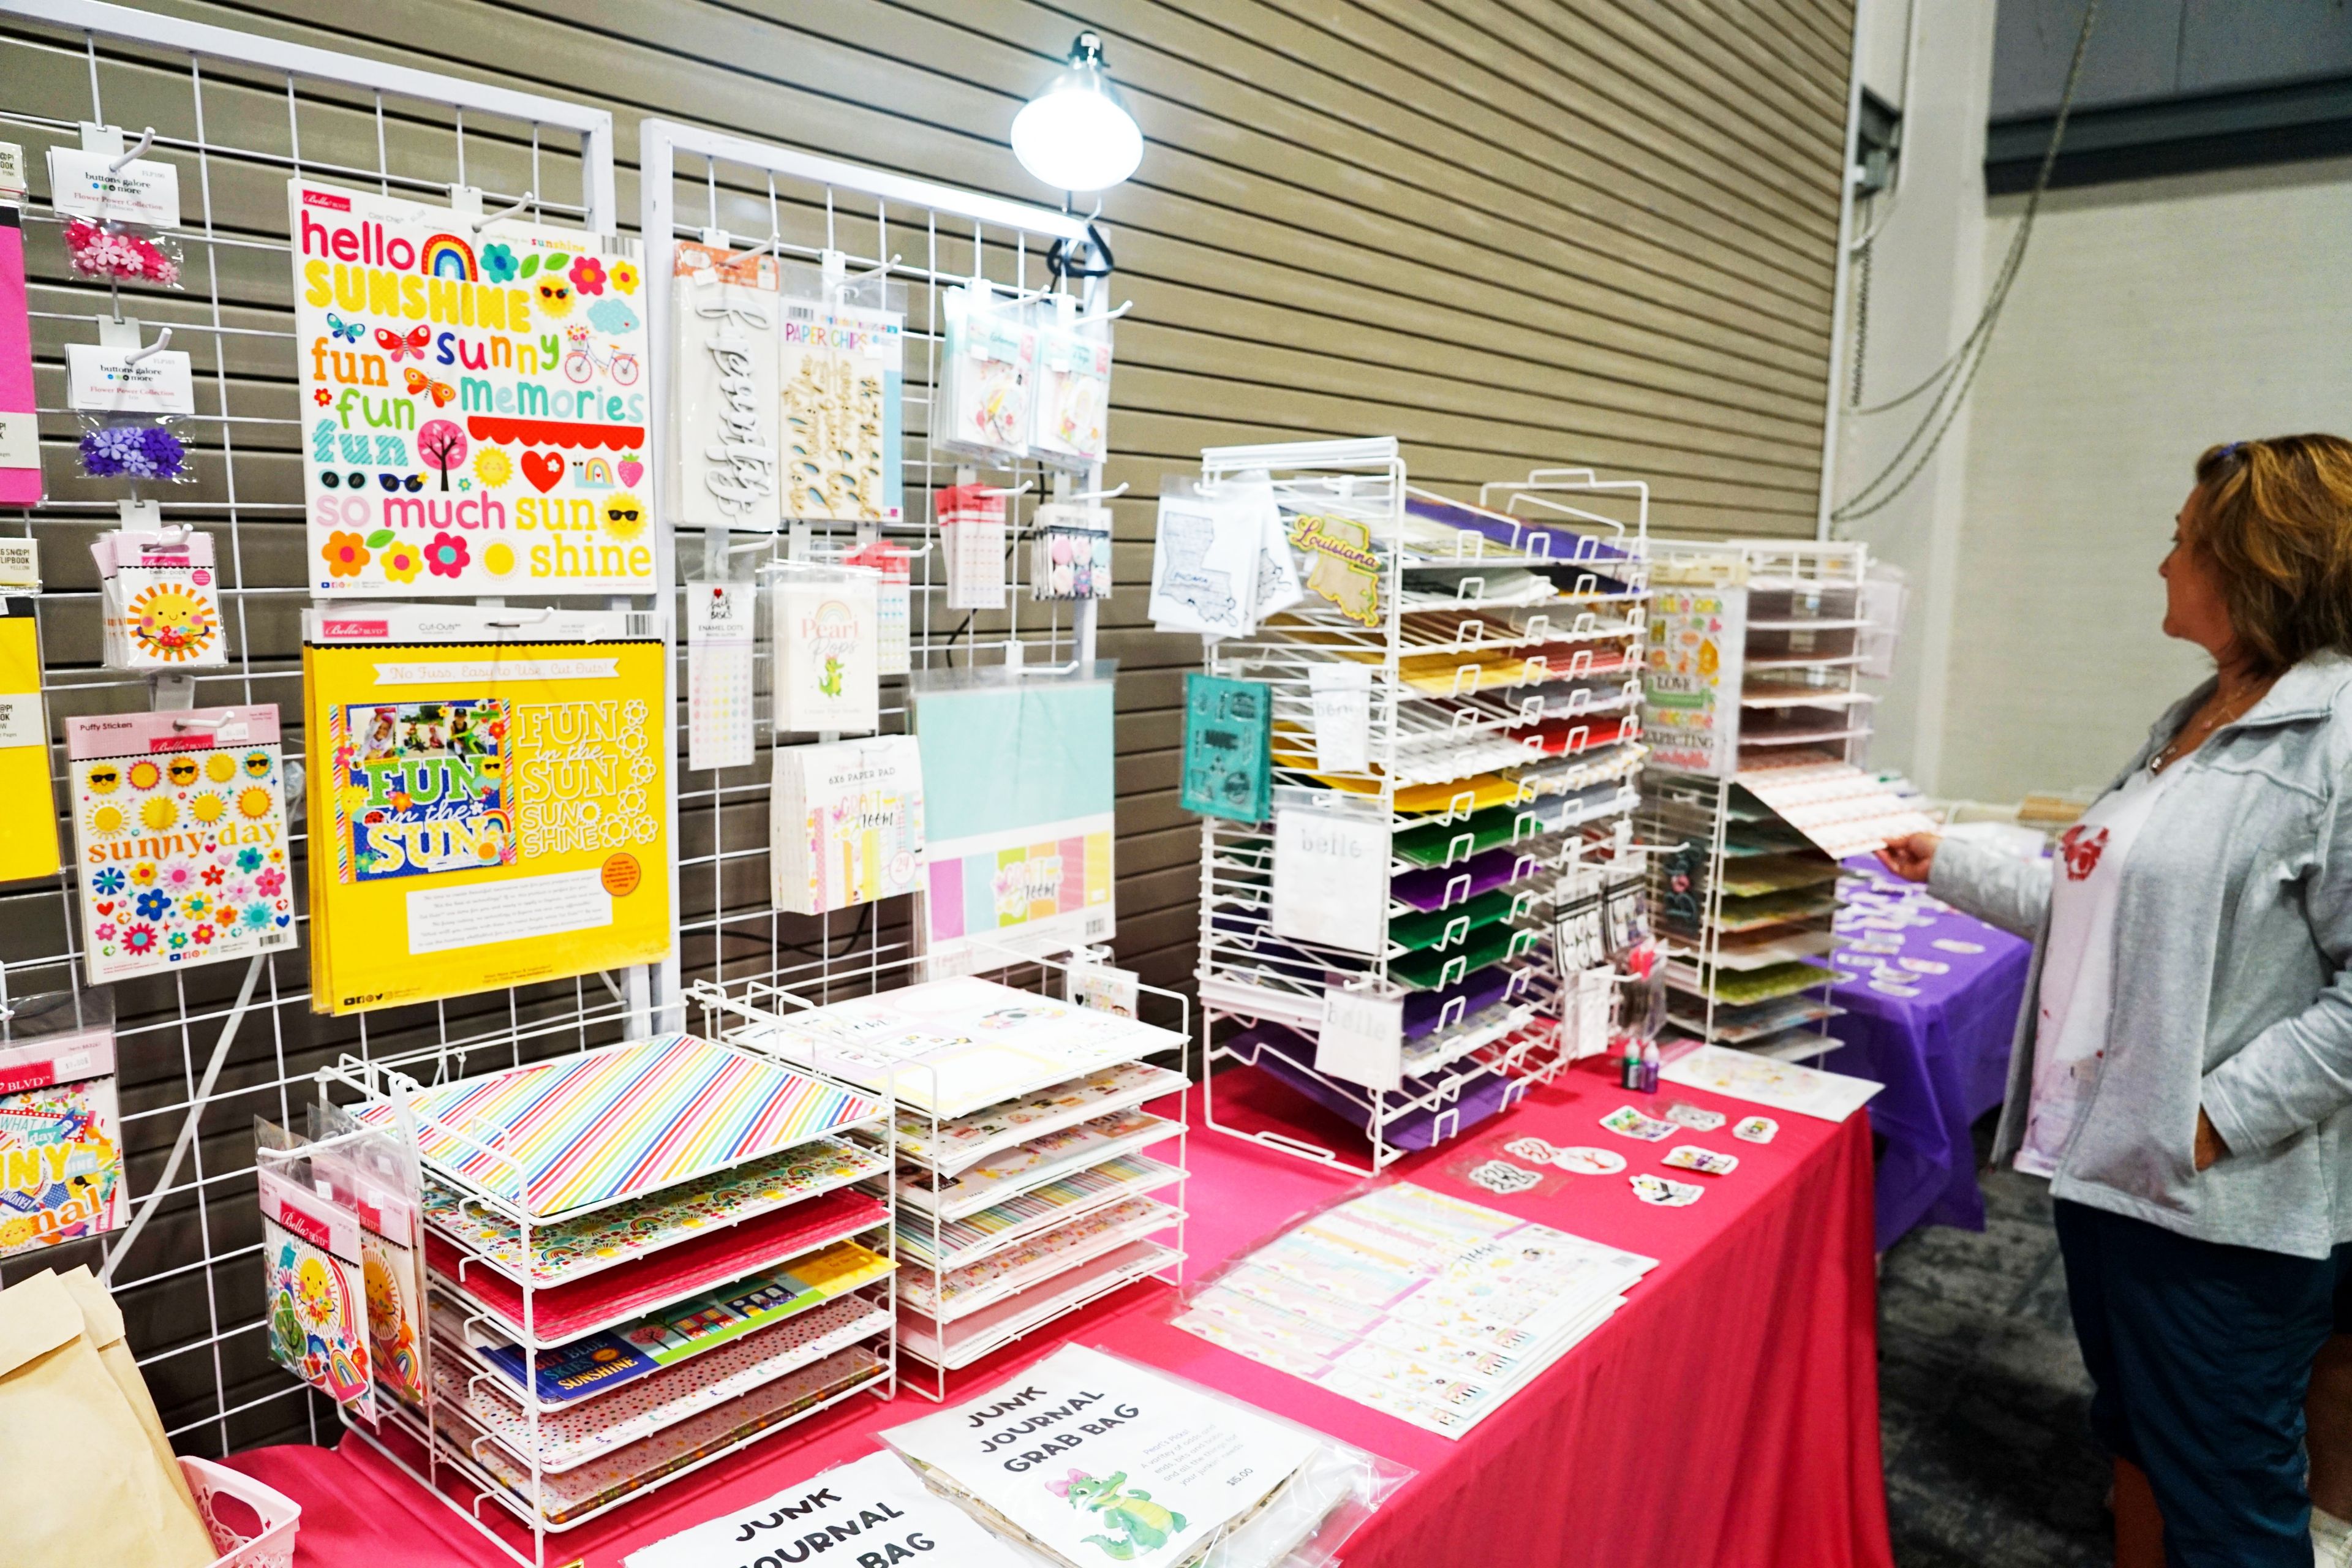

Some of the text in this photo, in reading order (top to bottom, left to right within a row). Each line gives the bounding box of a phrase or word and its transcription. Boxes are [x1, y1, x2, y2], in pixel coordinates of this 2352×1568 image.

[85, 172, 151, 189] buttons galore
[74, 192, 163, 210] Flower Power Collection
[301, 209, 415, 270] hello
[531, 238, 586, 252] sunshine
[305, 259, 532, 333] SUNSHINE
[786, 323, 827, 347] PAPER
[312, 337, 388, 387] fun
[437, 333, 559, 374] sunny
[336, 388, 415, 430] fun
[461, 377, 644, 423] memories
[312, 418, 409, 467] fun
[316, 491, 506, 529] so much
[516, 497, 598, 531] sun
[530, 534, 652, 577] shine
[1294, 518, 1376, 567] Louisiana
[325, 624, 363, 635] Bella
[802, 618, 862, 638] Pearl
[809, 636, 859, 663] Pops
[390, 667, 412, 679] No
[461, 666, 493, 680] Easy
[102, 722, 133, 730] Stickers
[518, 701, 618, 747] FUN
[568, 739, 604, 760] the
[362, 754, 489, 809] FUN
[521, 755, 618, 804] SUN
[848, 771, 875, 782] PAPER
[878, 767, 895, 777] PAD
[425, 800, 471, 822] the
[521, 801, 581, 832] SUN
[89, 821, 281, 862] sunny day
[368, 816, 489, 873] SUN
[522, 824, 601, 858] SHINE
[0, 1117, 37, 1131] WHAT
[32, 1131, 55, 1144] day
[282, 1211, 309, 1236] Bella
[544, 1358, 594, 1379] SKIES
[967, 1385, 1048, 1428] JUNK
[980, 1389, 1105, 1453] JOURNAL
[1003, 1403, 1139, 1473] GRAB BAG
[1143, 1440, 1170, 1455] Pearl's
[1175, 1452, 1190, 1463] bits
[1190, 1442, 1205, 1454] and
[1164, 1471, 1180, 1482] and
[1190, 1456, 1204, 1466] the
[1181, 1472, 1197, 1487] your
[736, 1488, 842, 1542] JUNK
[740, 1502, 905, 1568] OURNAL
[857, 1532, 935, 1568] BAG
